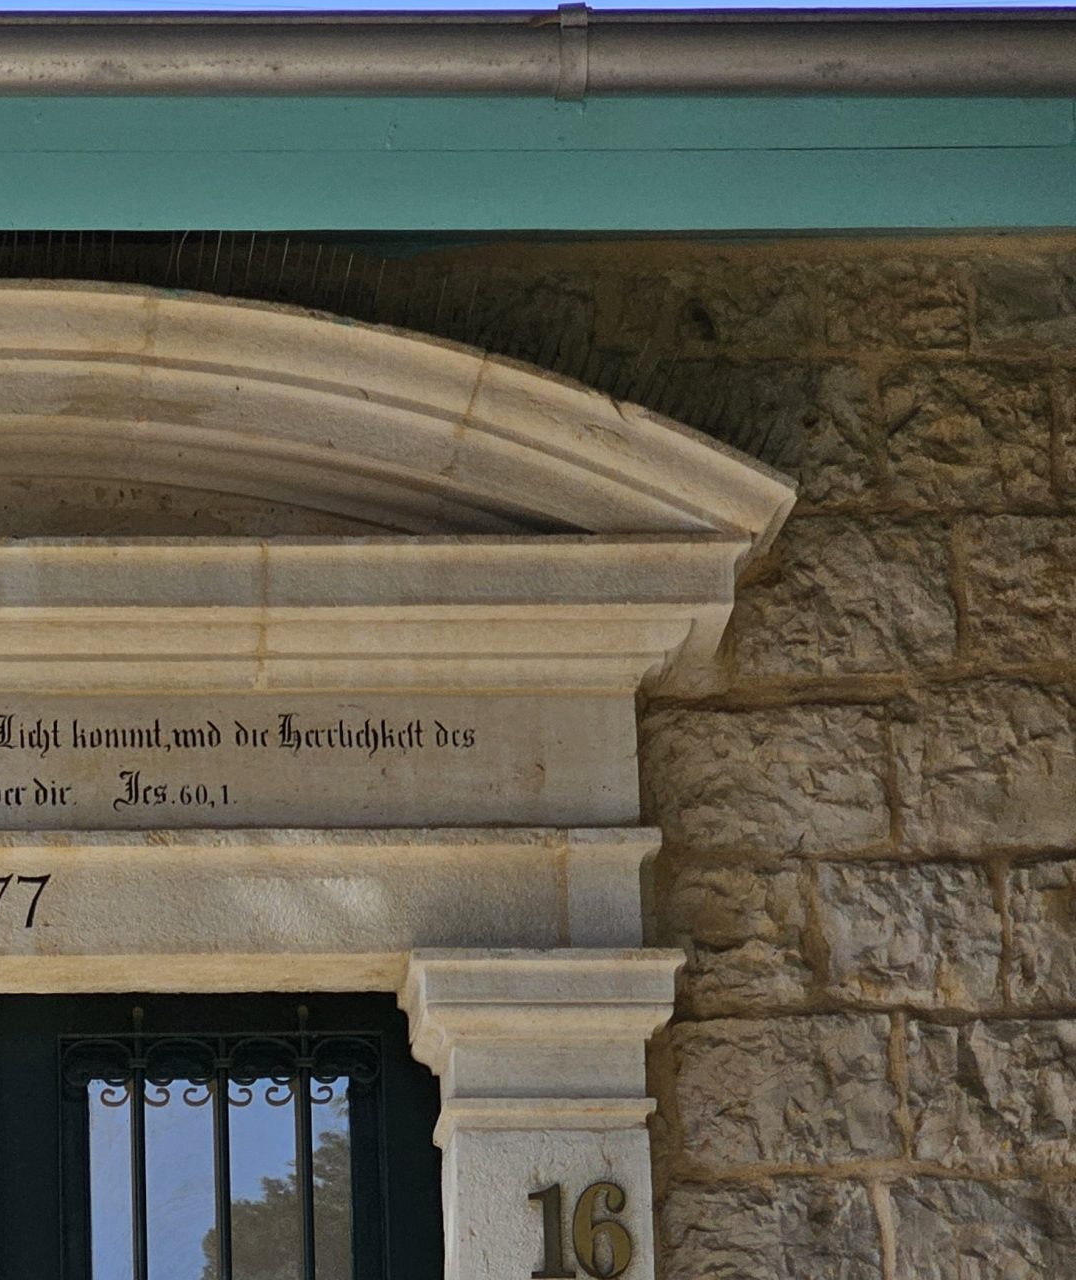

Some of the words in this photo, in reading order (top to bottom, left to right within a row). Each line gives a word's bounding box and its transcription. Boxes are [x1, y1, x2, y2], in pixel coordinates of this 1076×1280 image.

[234, 720, 269, 748] die
[434, 720, 475, 748] des
[527, 1181, 633, 1280] 16
